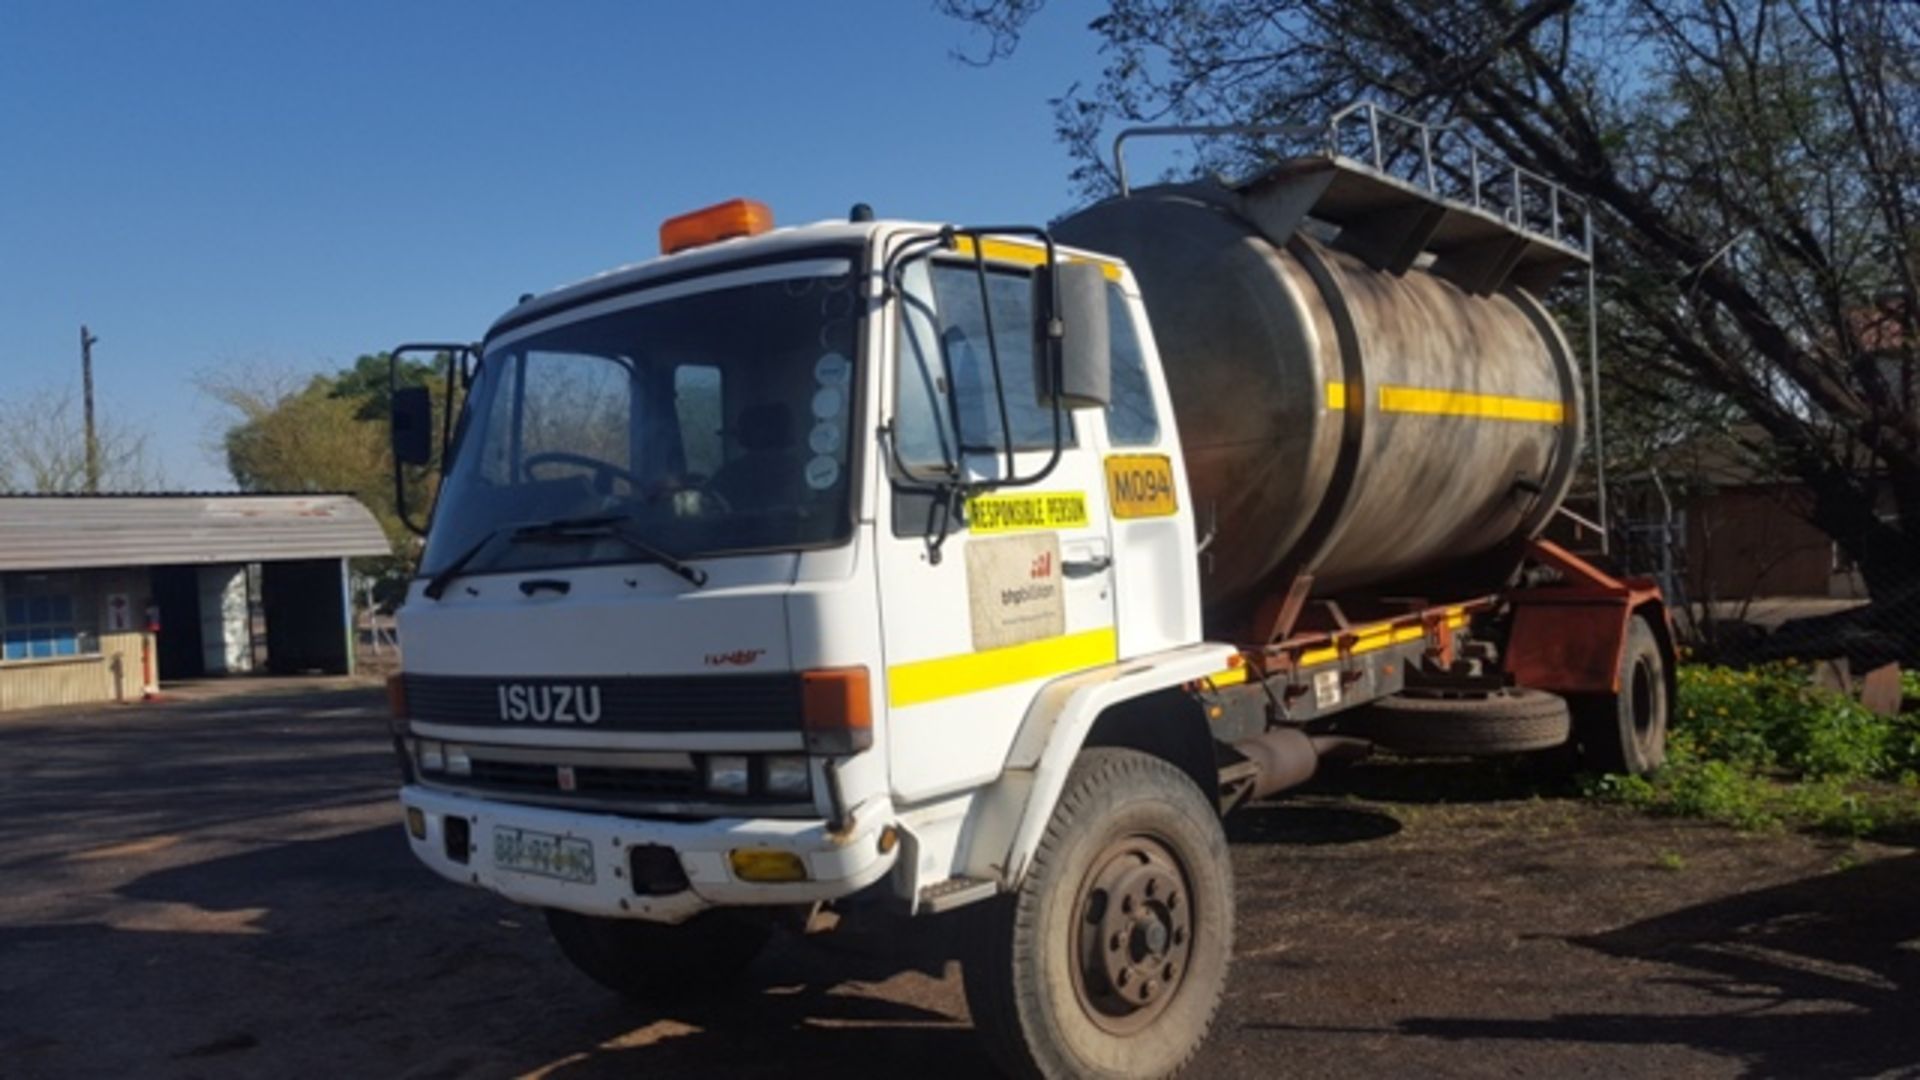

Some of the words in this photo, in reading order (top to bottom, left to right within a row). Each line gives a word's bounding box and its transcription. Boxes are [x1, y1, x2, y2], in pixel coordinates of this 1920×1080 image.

[970, 499, 1044, 529] RESPONSIBLE
[1046, 497, 1086, 523] PERSON
[498, 685, 601, 723] ISUZU
